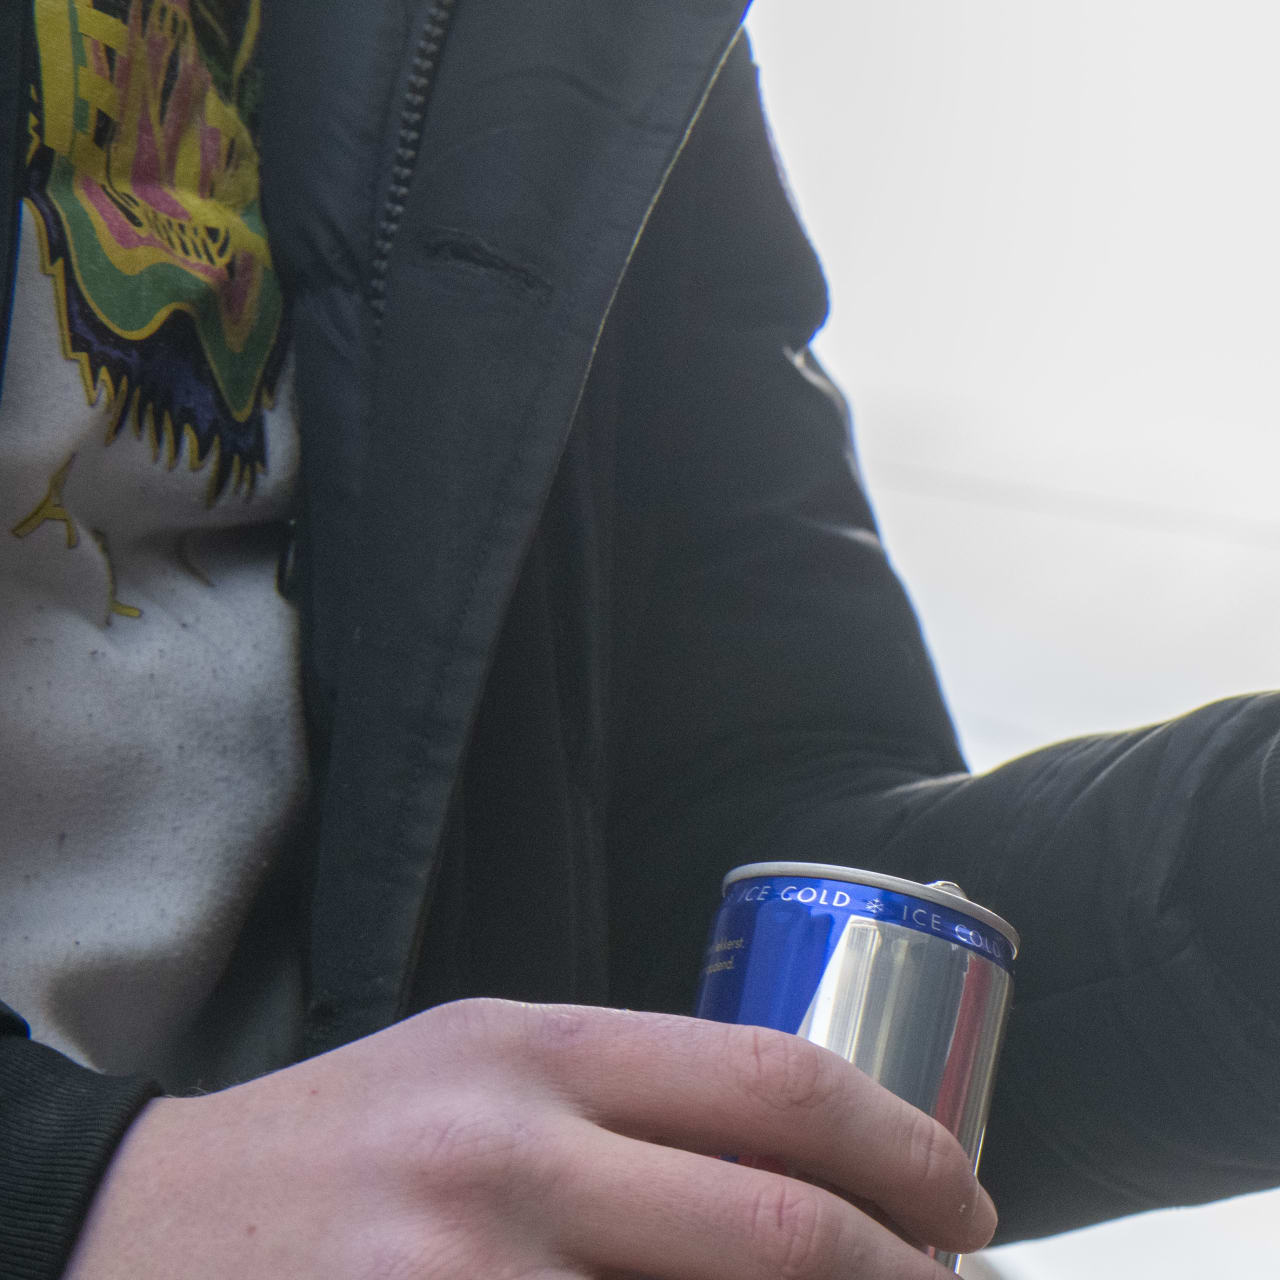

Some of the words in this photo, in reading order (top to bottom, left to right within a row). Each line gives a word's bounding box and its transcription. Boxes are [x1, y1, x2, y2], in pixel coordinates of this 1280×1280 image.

[737, 885, 771, 902] ICE
[780, 885, 851, 908] COLD
[902, 904, 942, 932] ICE
[953, 923, 1003, 958] COLD
